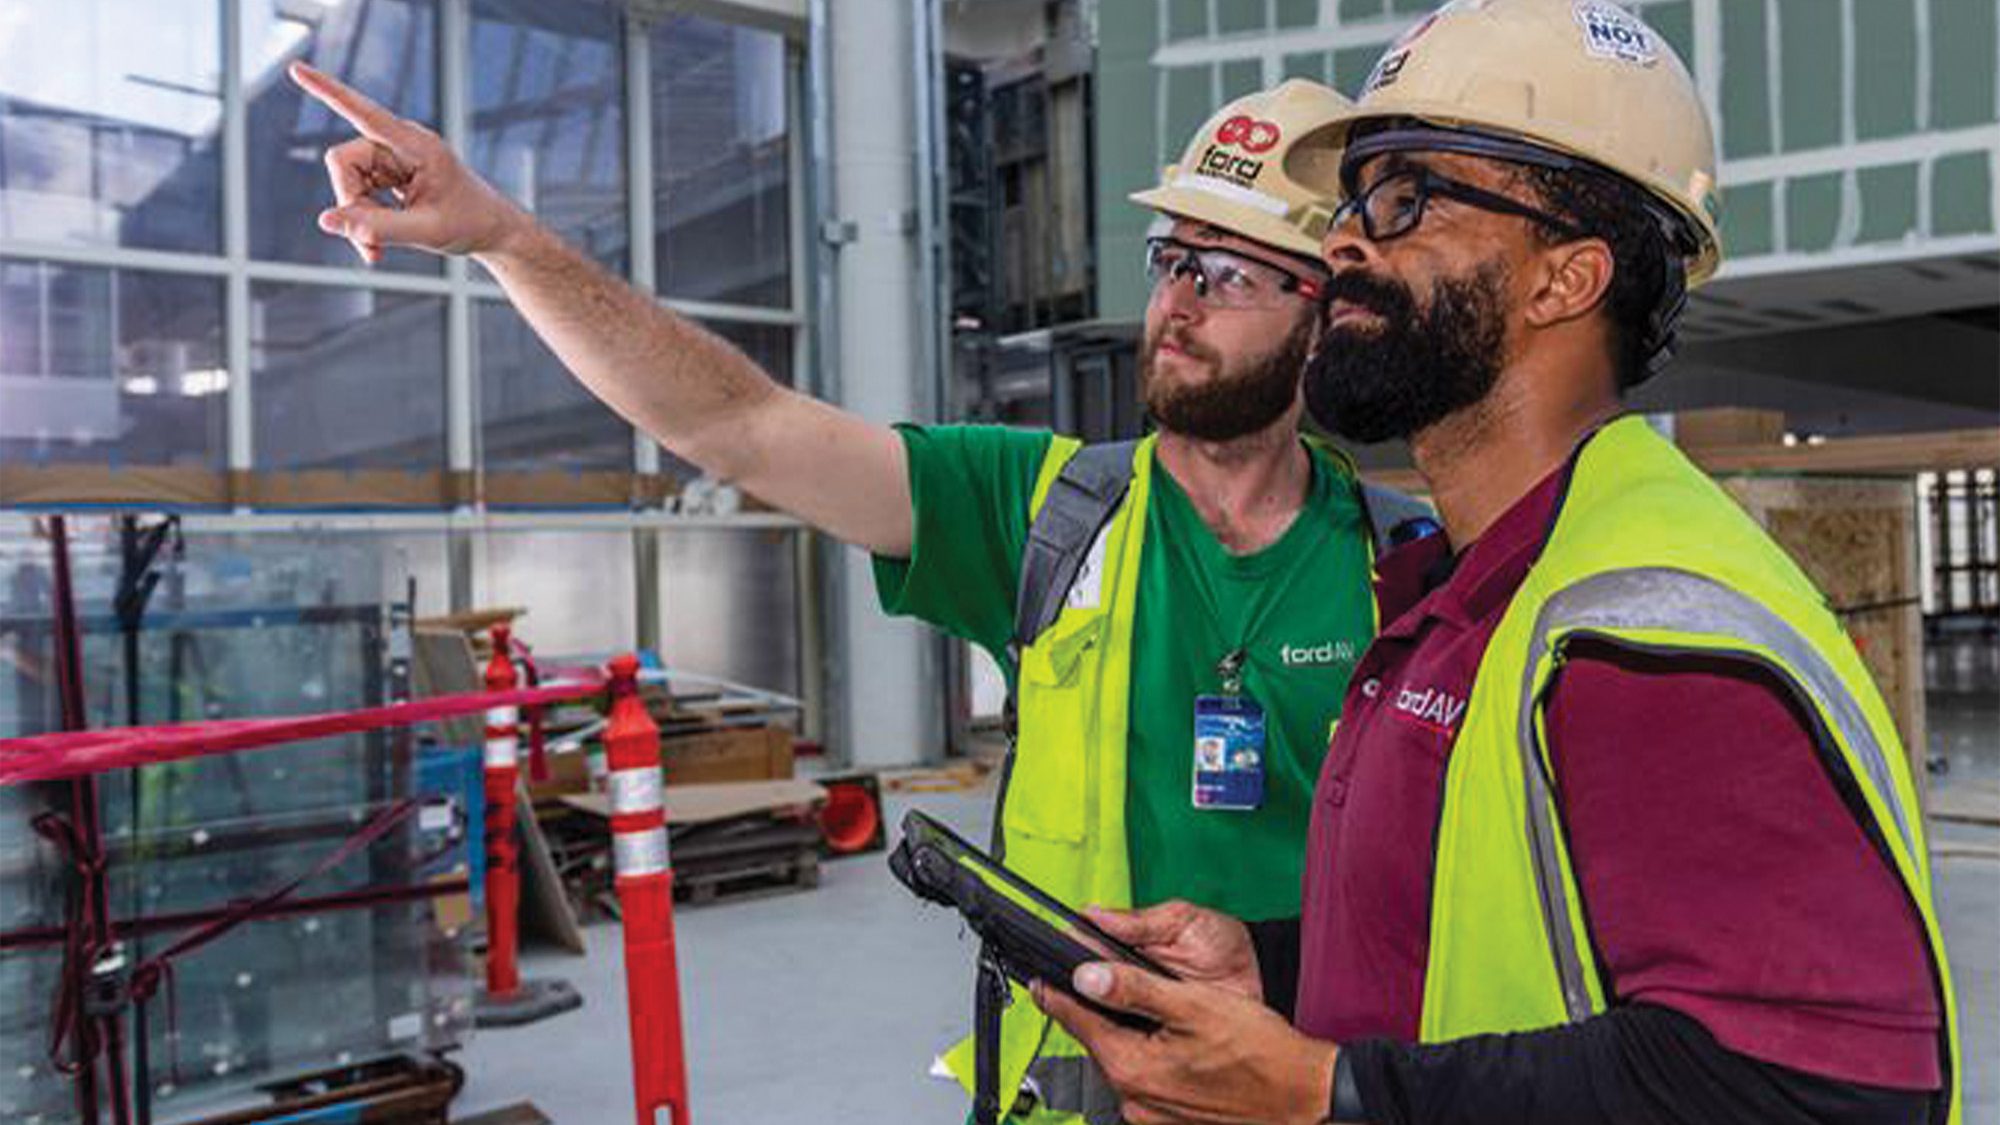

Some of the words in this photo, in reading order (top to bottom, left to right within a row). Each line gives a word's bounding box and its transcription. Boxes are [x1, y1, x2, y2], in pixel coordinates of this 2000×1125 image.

[1589, 23, 1646, 49] NOT
[1200, 144, 1263, 179] ford
[1397, 687, 1466, 727] ordAV
